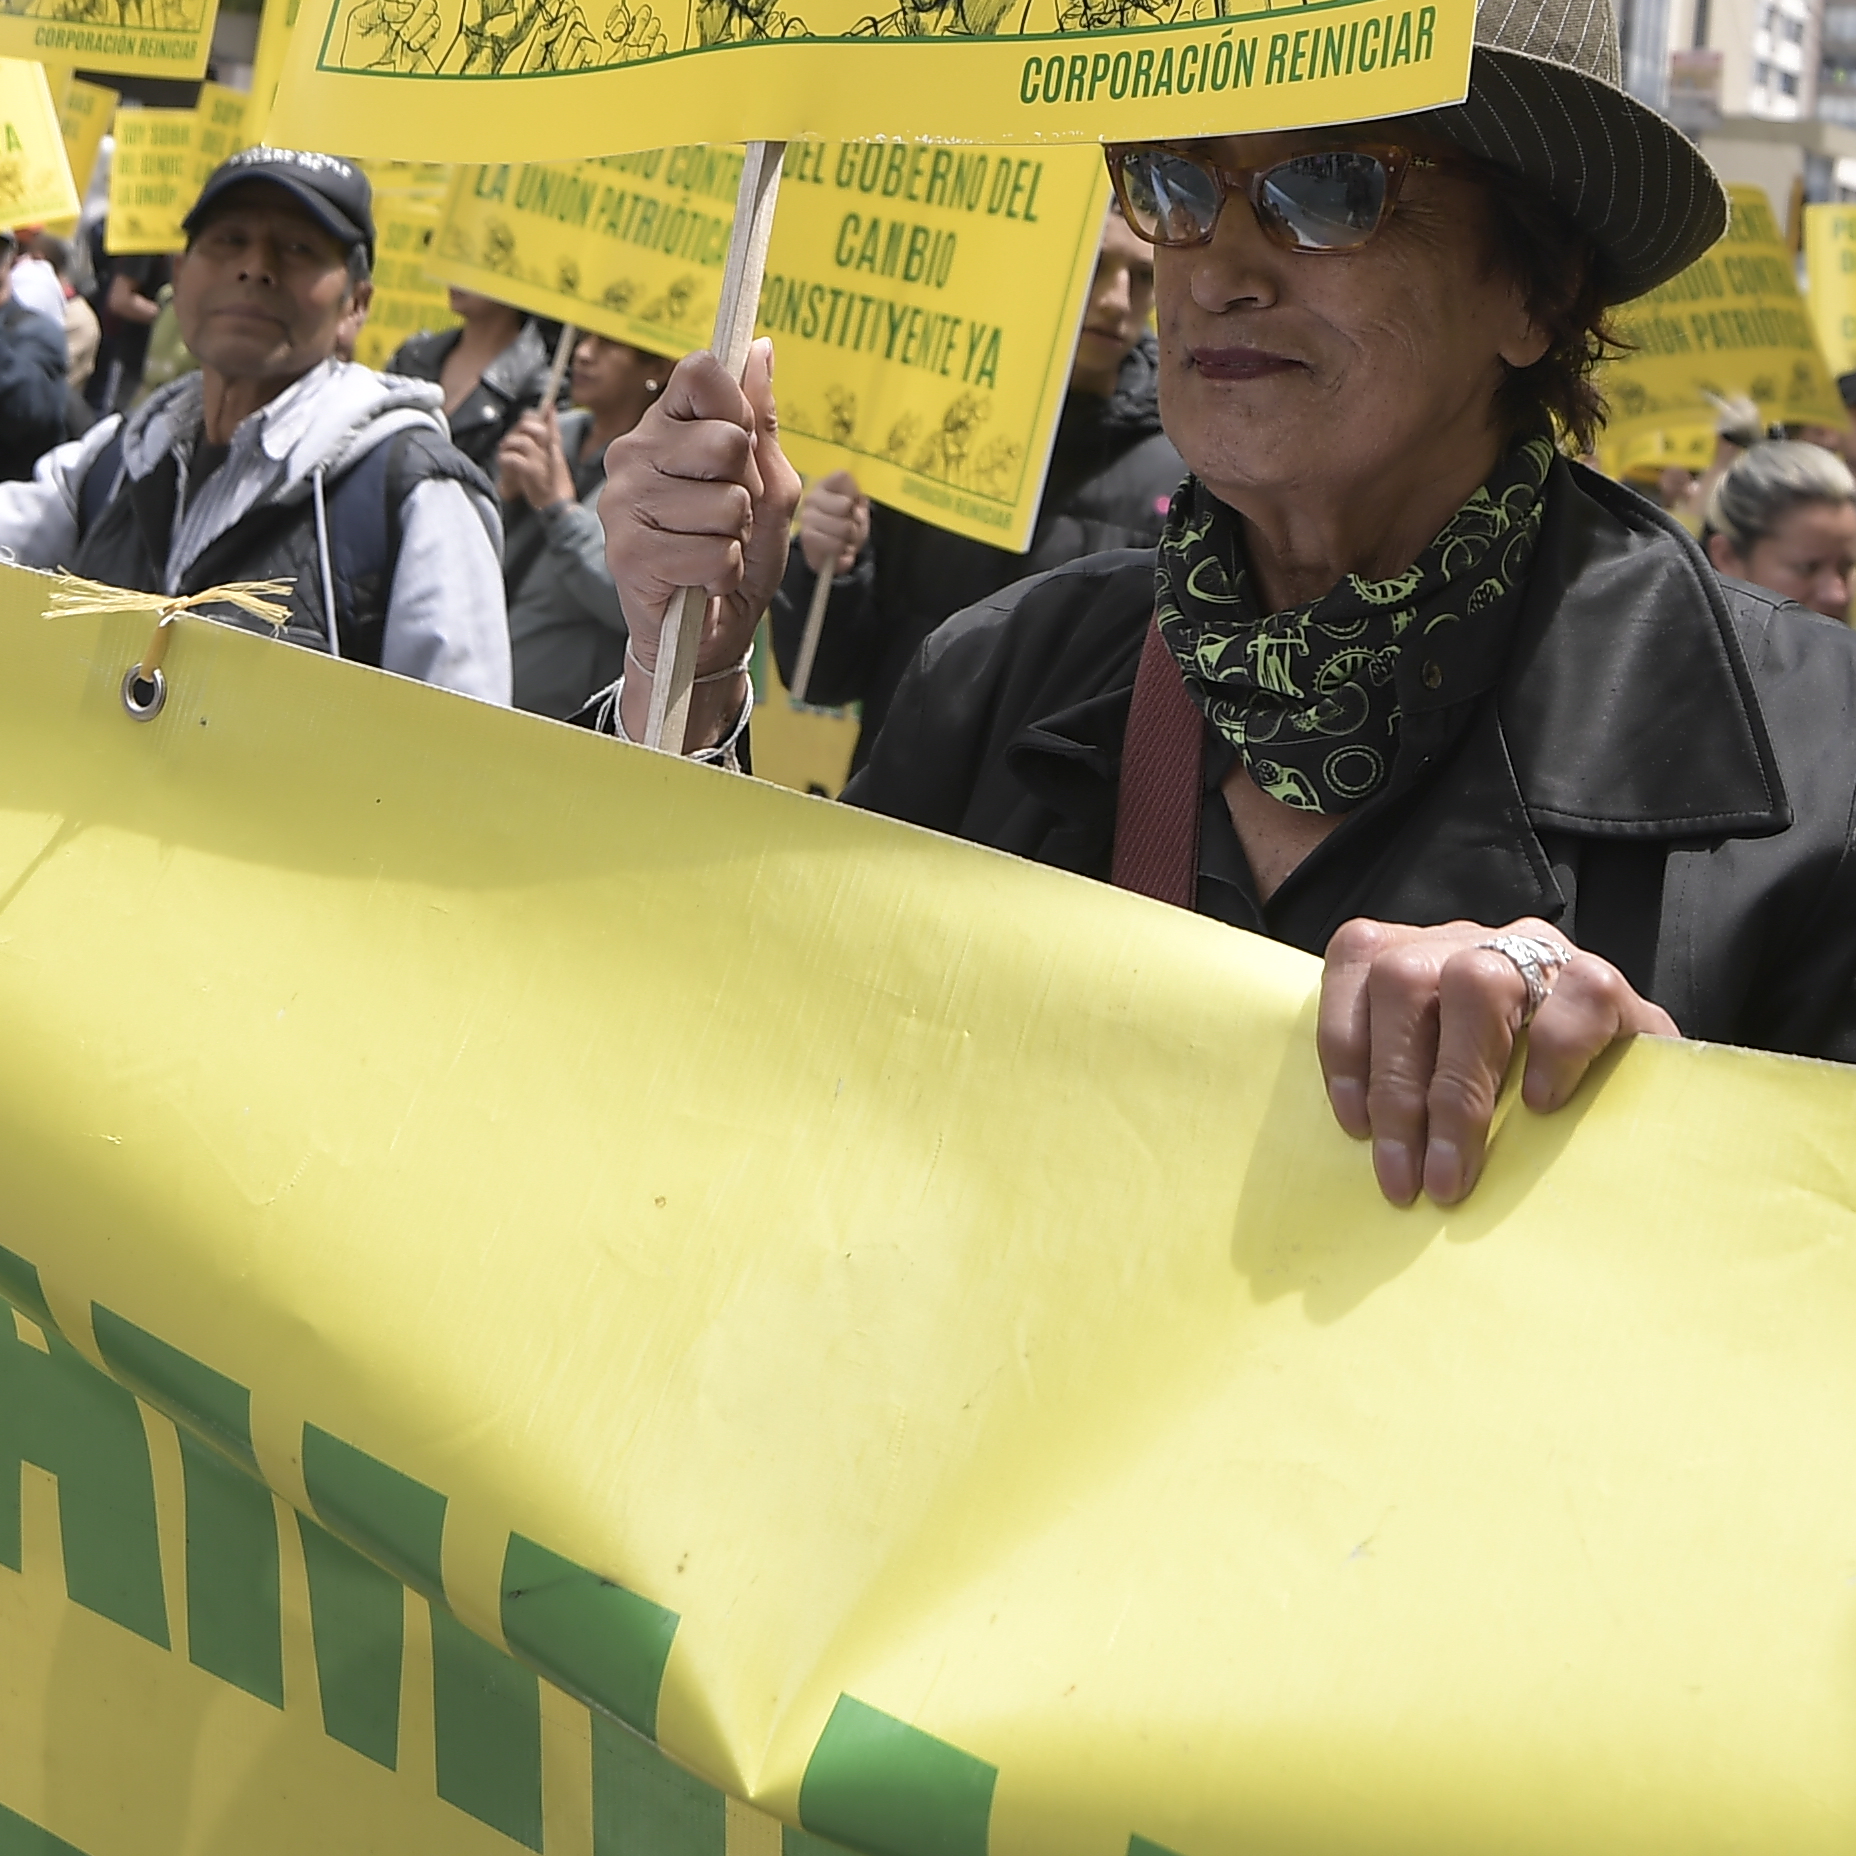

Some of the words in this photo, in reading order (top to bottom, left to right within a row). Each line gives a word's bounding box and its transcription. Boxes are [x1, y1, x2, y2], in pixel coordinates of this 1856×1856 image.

[1019, 25, 1261, 107] CORPORACIÓN
[1266, 5, 1437, 94] REINICIAR
[988, 156, 1043, 223] DEL
[962, 322, 1003, 390] YA
